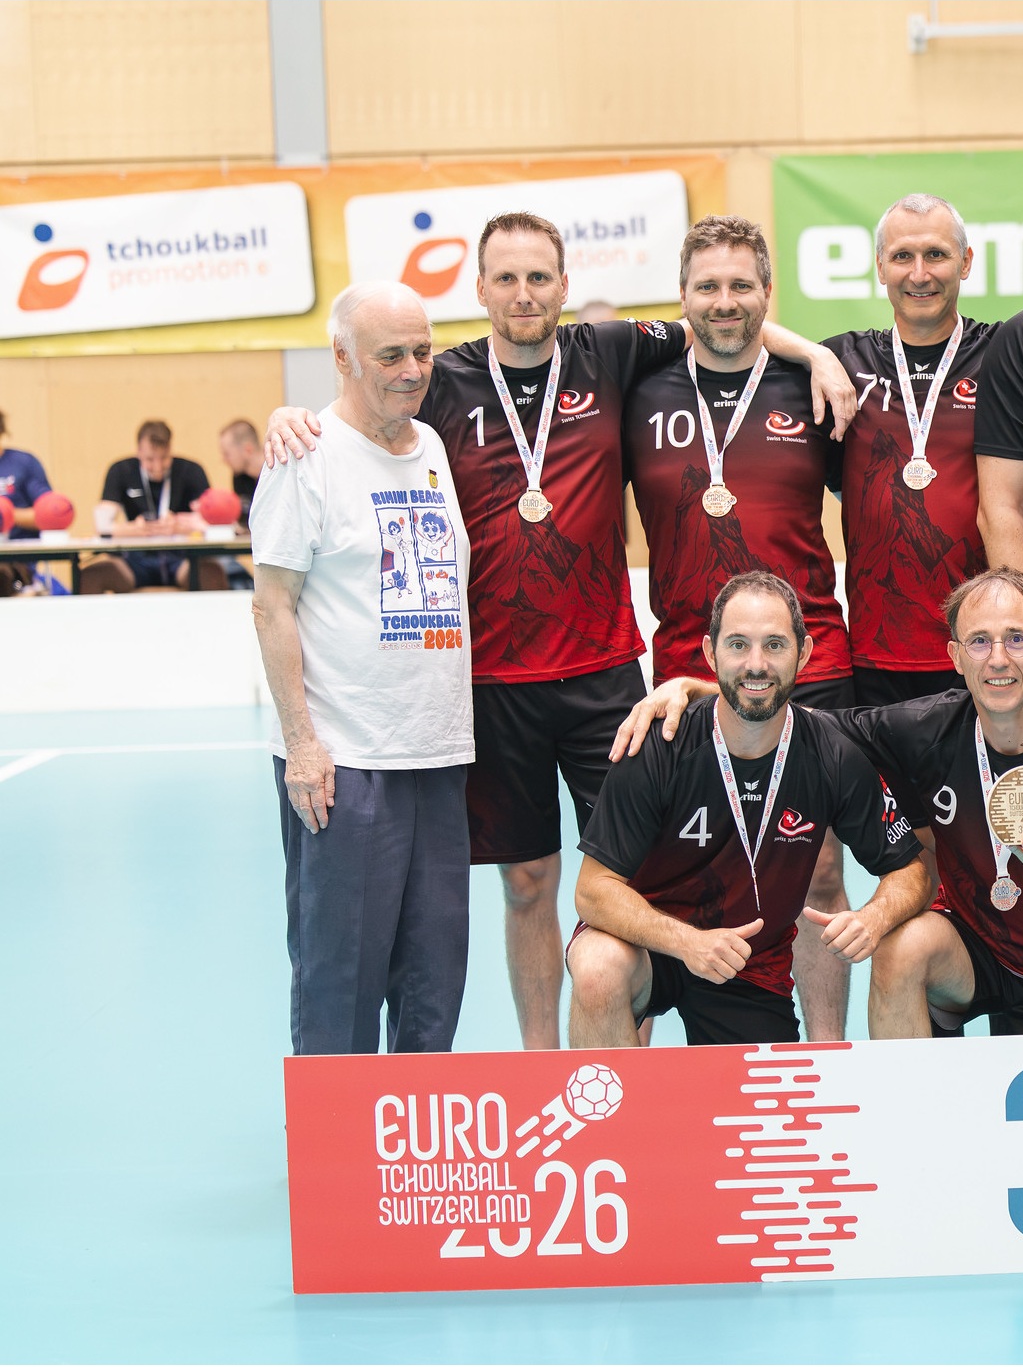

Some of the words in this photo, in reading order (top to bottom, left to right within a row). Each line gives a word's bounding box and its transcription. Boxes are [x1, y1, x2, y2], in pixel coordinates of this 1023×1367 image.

[106, 226, 268, 261] tchoukball
[713, 399, 740, 408] erim
[468, 406, 485, 447] 1
[648, 409, 696, 450] 10
[371, 489, 408, 506] RIMINI
[410, 489, 446, 505] BEACH
[380, 613, 462, 631] TCHOUKBALL
[379, 631, 423, 642] FESTIVAL
[423, 629, 463, 650] 2026
[933, 785, 958, 825] 9
[678, 806, 712, 847] 4
[374, 1092, 509, 1161] EURO
[377, 1162, 518, 1194] TCHOUKBALL
[378, 1193, 532, 1226] SWITZERLAND
